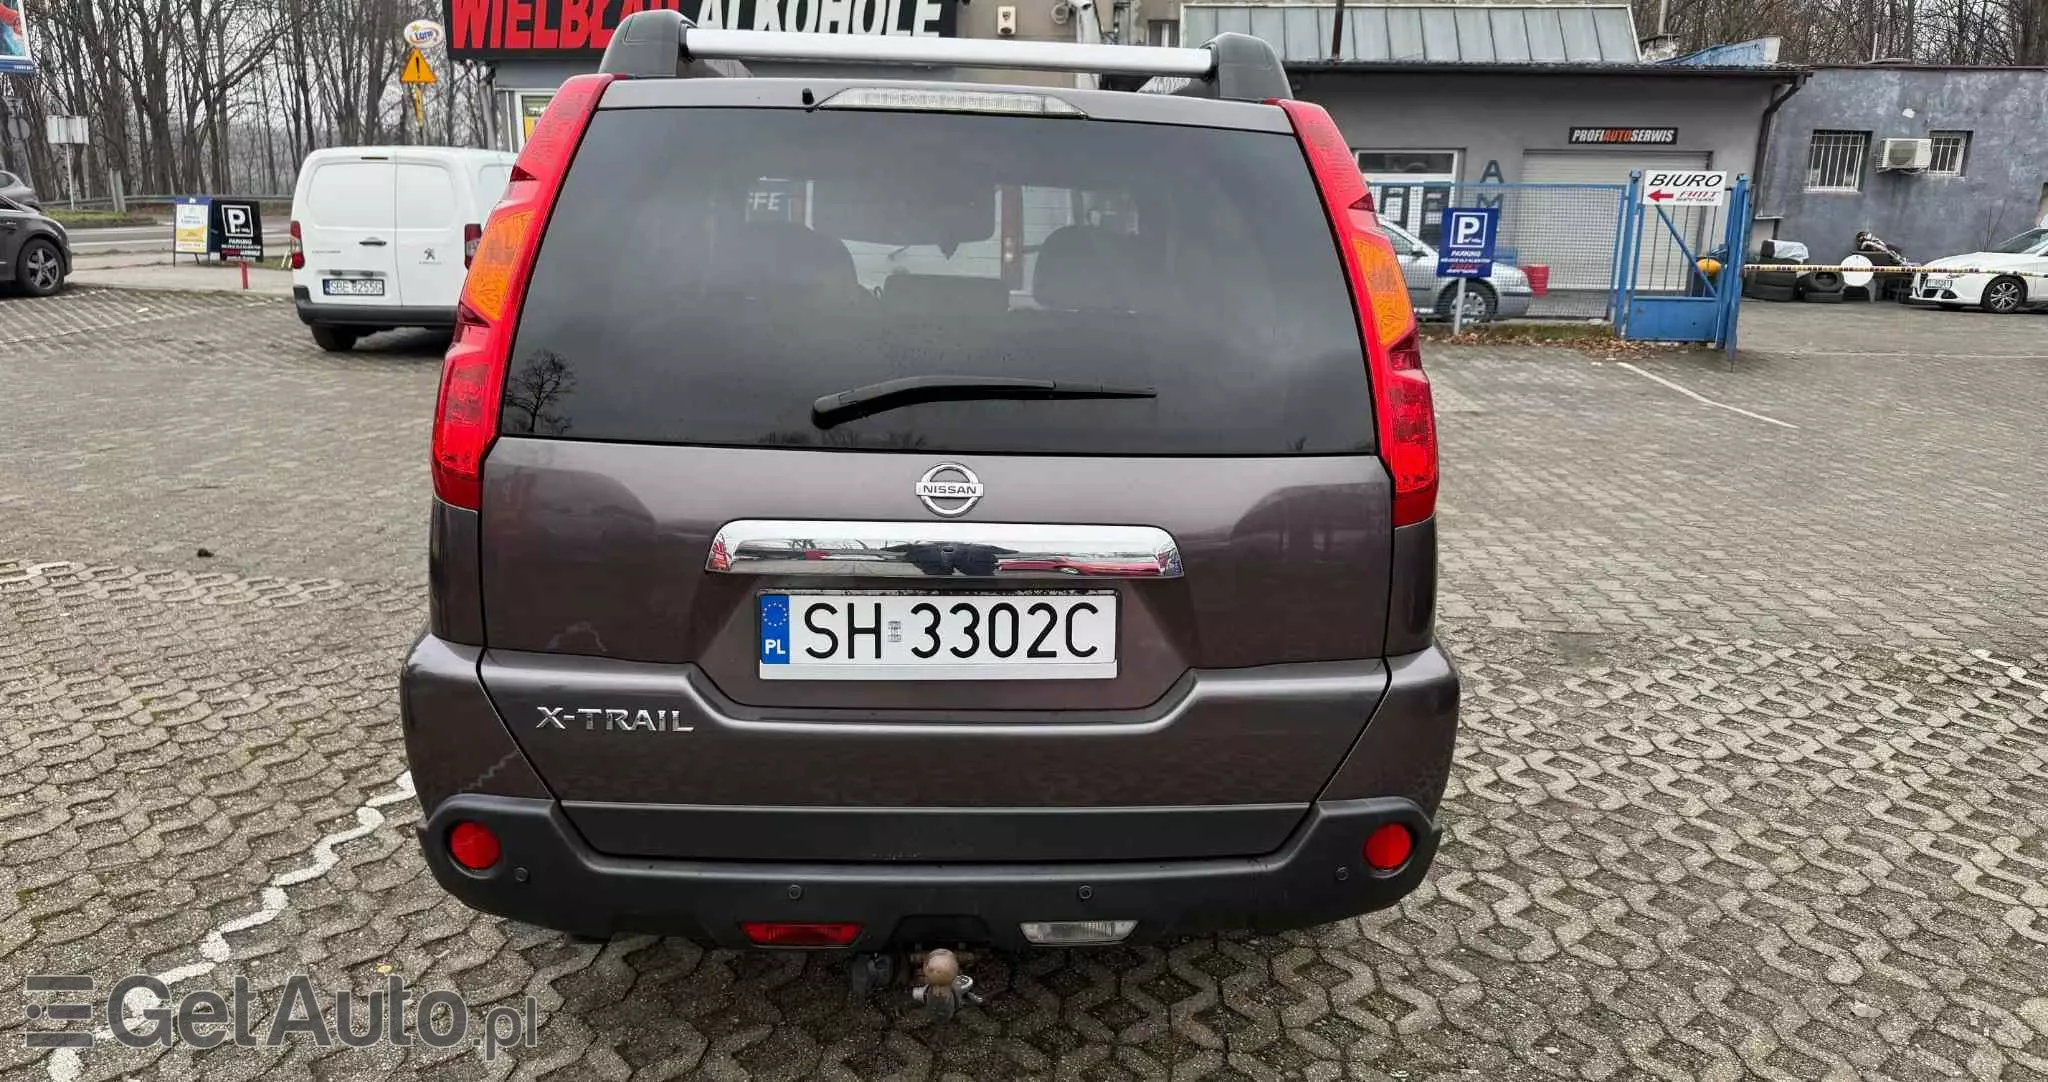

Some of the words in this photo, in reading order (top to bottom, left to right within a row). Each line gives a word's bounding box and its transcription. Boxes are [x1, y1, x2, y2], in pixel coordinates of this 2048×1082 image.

[1648, 173, 1723, 188] BIURO
[923, 484, 977, 495] NISSAN
[803, 602, 882, 659] SH
[909, 601, 1099, 659] 3302C
[765, 639, 786, 655] PL
[535, 706, 695, 732] X-TRAIL
